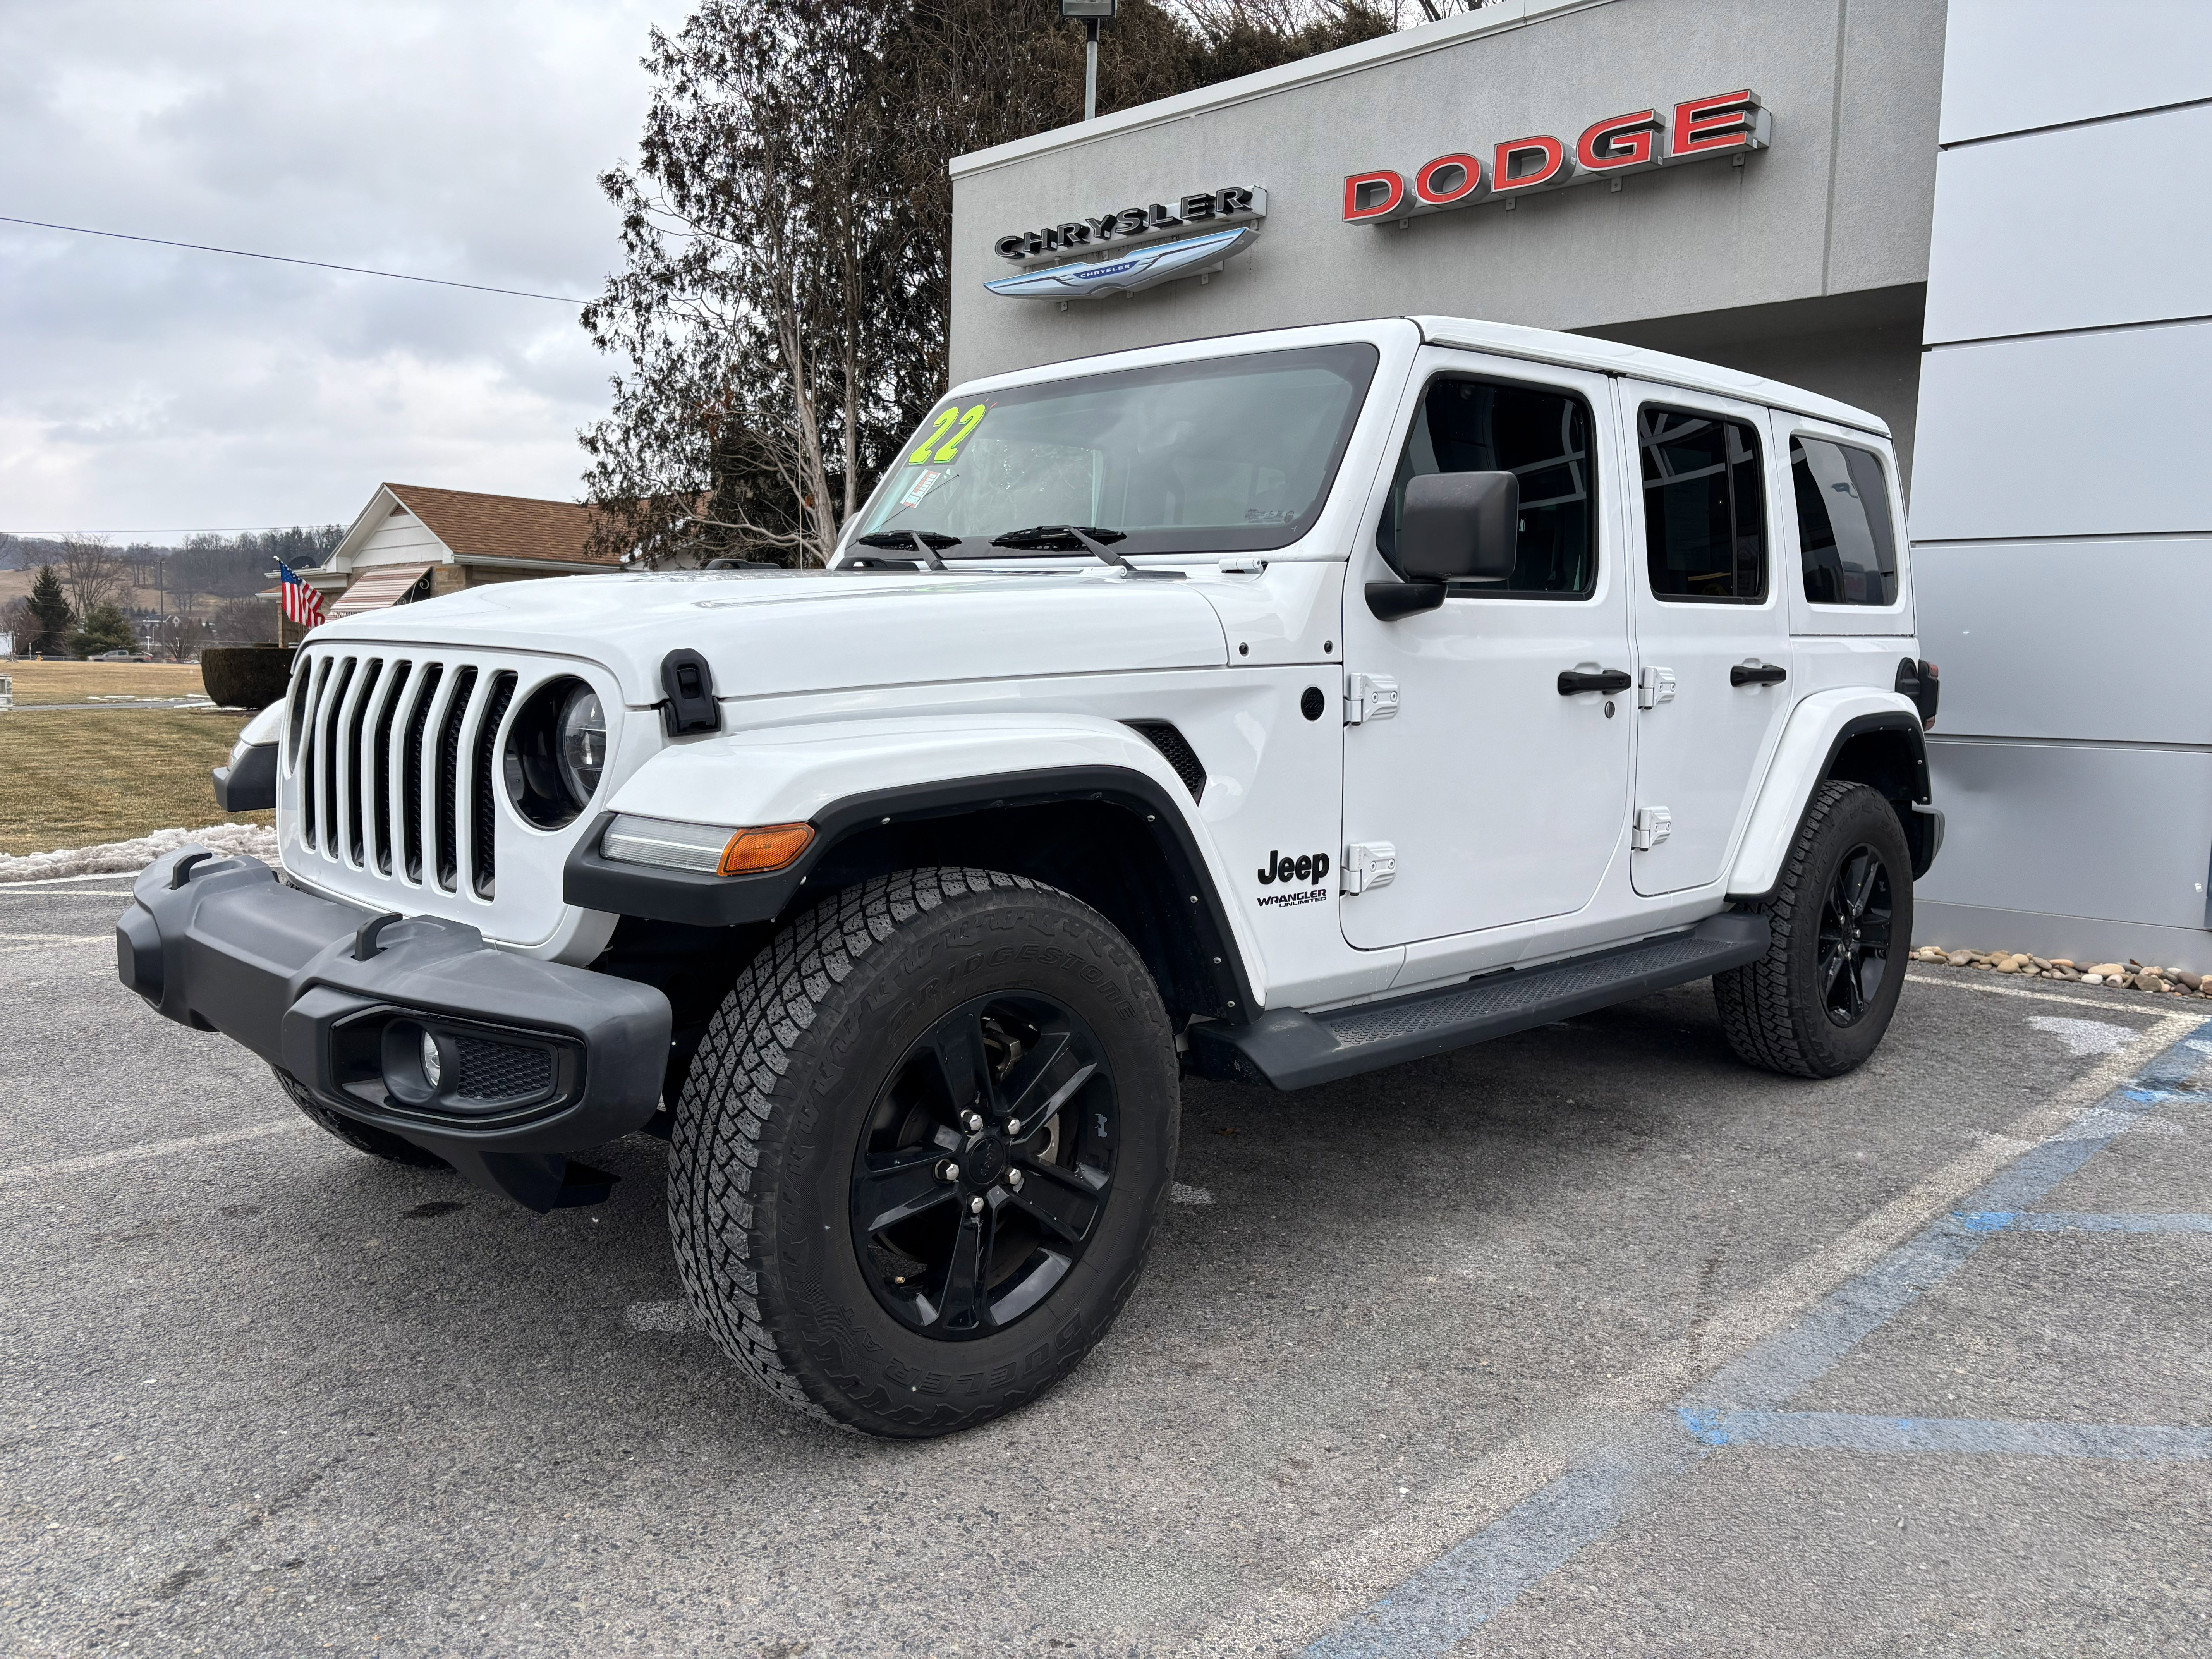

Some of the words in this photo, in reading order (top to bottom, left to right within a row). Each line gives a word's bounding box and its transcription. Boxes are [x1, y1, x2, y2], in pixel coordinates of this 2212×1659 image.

[1342, 89, 1754, 222] DODGE
[994, 187, 1252, 259] CHRYSLER
[1080, 264, 1130, 277] CHRYSLER
[908, 404, 986, 465] 22
[1257, 850, 1329, 885] Jeep
[1257, 889, 1326, 907] WRANGLER
[1279, 896, 1327, 908] UNLIMITED
[887, 941, 1138, 1036] BRIDGESTONE
[839, 1304, 883, 1352] A/T
[883, 1308, 1082, 1396] DUELER
